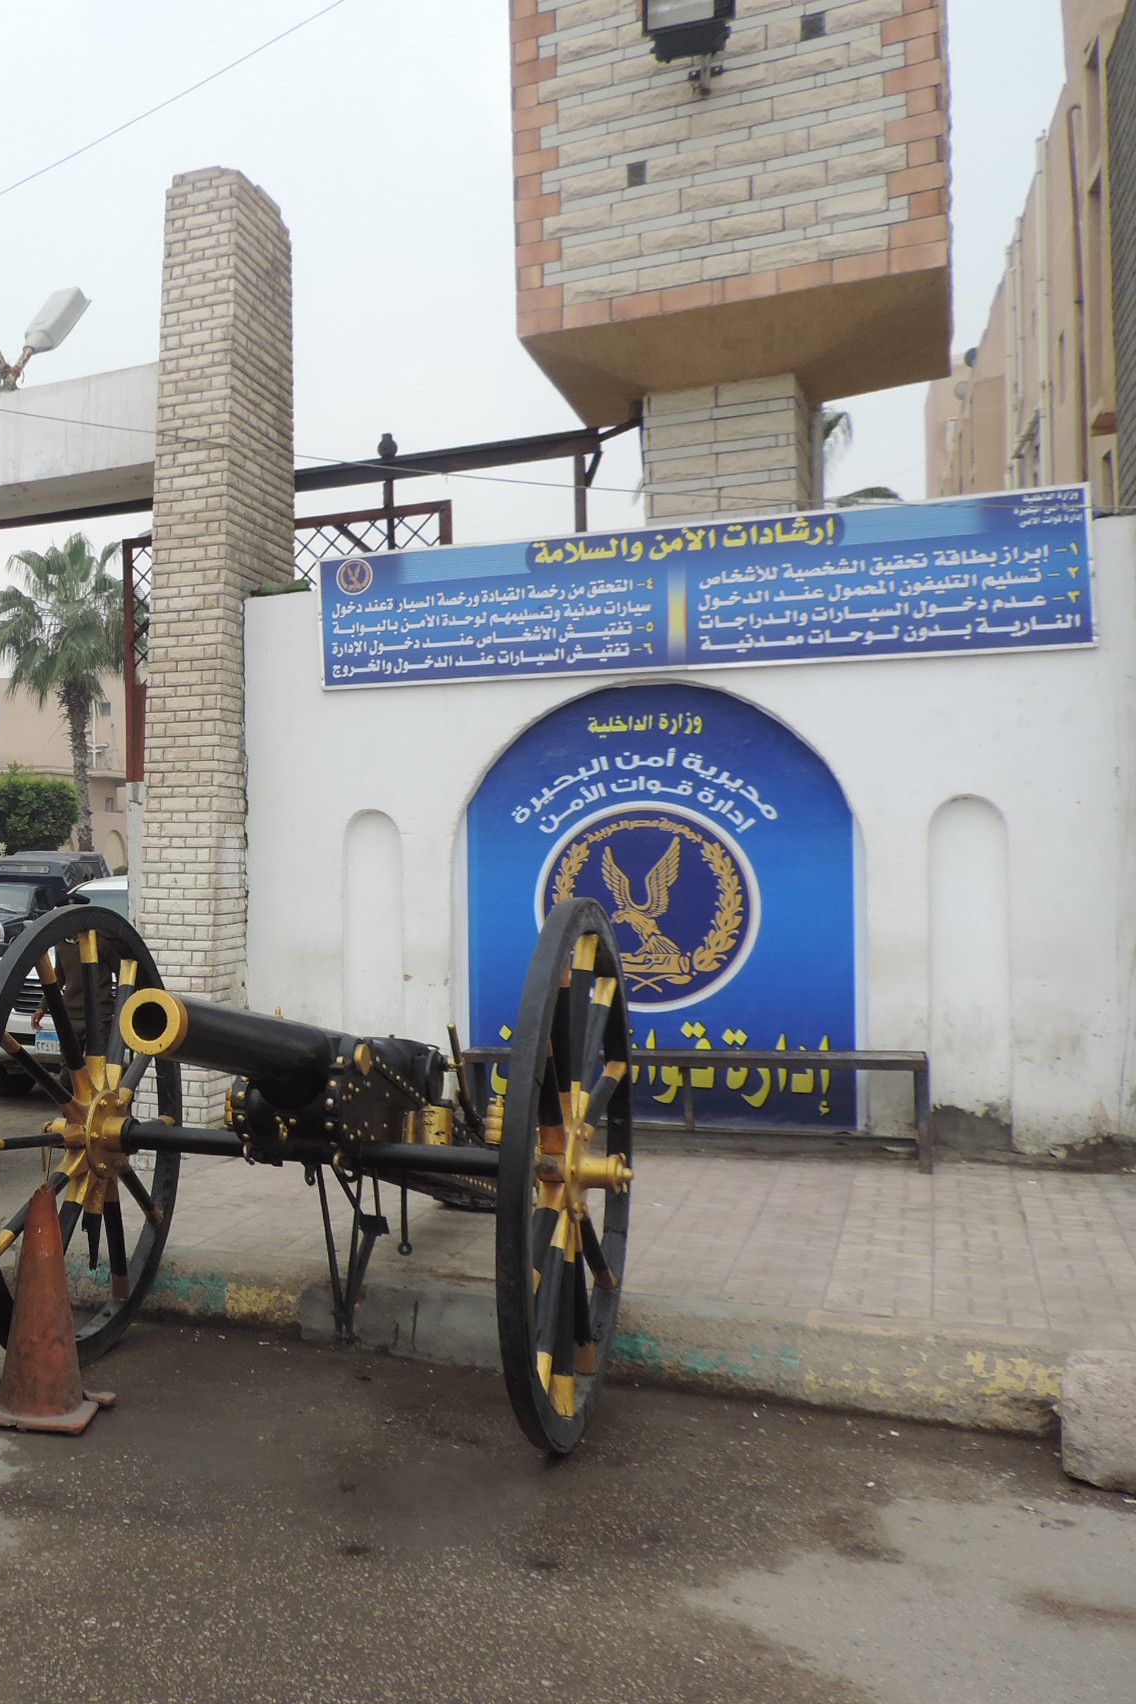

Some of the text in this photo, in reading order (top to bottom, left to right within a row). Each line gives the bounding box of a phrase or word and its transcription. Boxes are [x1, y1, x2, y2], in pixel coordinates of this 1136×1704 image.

[534, 516, 835, 564] إرشادات الأمن والسلامة
[869, 552, 928, 576] تحقيق
[933, 548, 998, 567] بطاقة
[1000, 544, 1049, 564] إبراز
[698, 563, 778, 589] للأشخاص
[782, 557, 866, 582] الشخصية
[981, 567, 1042, 590] تسليم
[527, 583, 565, 600] رخصة
[567, 584, 585, 600] من
[587, 578, 634, 599] التحقق
[773, 586, 825, 602] عند
[828, 579, 895, 602] المحمول
[898, 573, 978, 597] التليفون
[437, 591, 480, 608] ورخصة
[481, 586, 526, 606] القيادة
[697, 590, 769, 611] الدخول
[992, 595, 1047, 613] عدم
[331, 600, 363, 618] دخول
[811, 602, 910, 624] السيارات
[913, 595, 989, 619] دخول
[331, 600, 652, 638] سيارات مدنية وتسليمهم لوحدة الأمن بالبوابة
[697, 609, 808, 630] والدراجات
[422, 633, 475, 649] عند
[558, 621, 633, 643] تفتيش
[698, 613, 1081, 653] النارية بدون لوحات معدنية
[331, 640, 367, 658] الإدارة
[369, 636, 420, 656] دخول
[566, 642, 630, 664] تفتيش
[393, 655, 453, 674] الدخول
[455, 651, 495, 667] عند
[497, 647, 564, 667] السيارات
[332, 659, 392, 678] والخروج
[587, 712, 703, 739] وزارة الداخلية
[510, 747, 779, 824] مديرية أمن البحيرة
[538, 775, 756, 834] إدارة قوات الأمن
[630, 1021, 716, 1104] قوا
